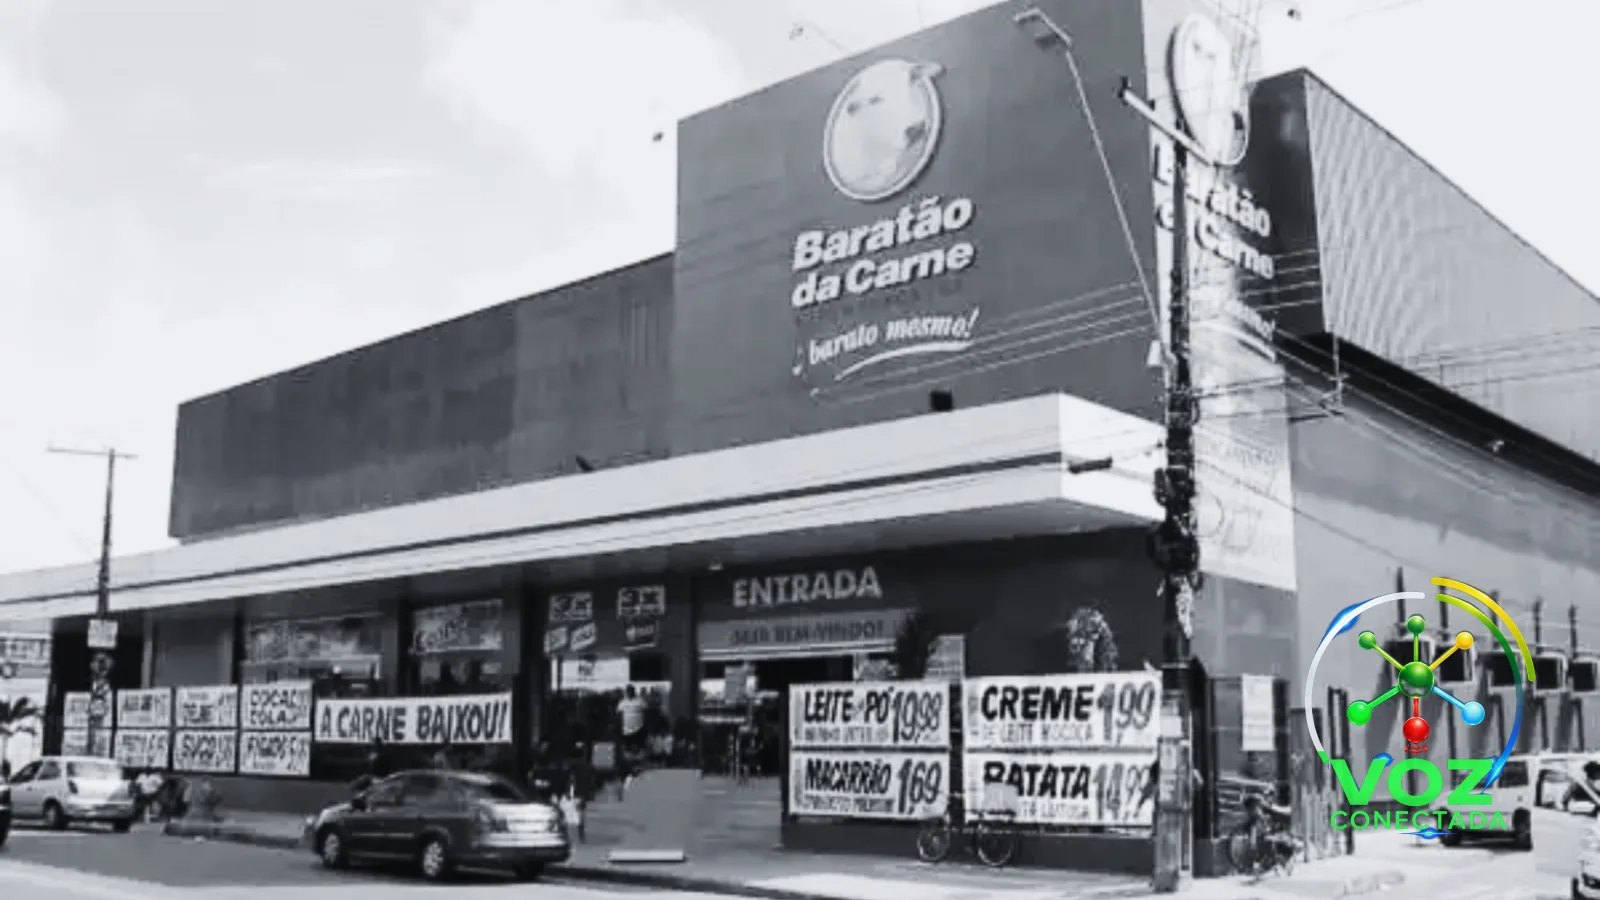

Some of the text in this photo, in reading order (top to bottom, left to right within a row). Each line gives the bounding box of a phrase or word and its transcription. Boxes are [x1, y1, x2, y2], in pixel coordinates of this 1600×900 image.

[793, 196, 973, 270] Baratão
[791, 272, 841, 308] da
[846, 243, 974, 294] Carne
[886, 307, 980, 341] mesmo!
[733, 566, 883, 608] ENTRADA
[321, 701, 508, 741] A CARNE BAIXOU!
[804, 689, 853, 723] LEITE
[864, 686, 894, 724] PÓ
[981, 686, 1094, 721] CREME
[897, 758, 942, 815] 1,69
